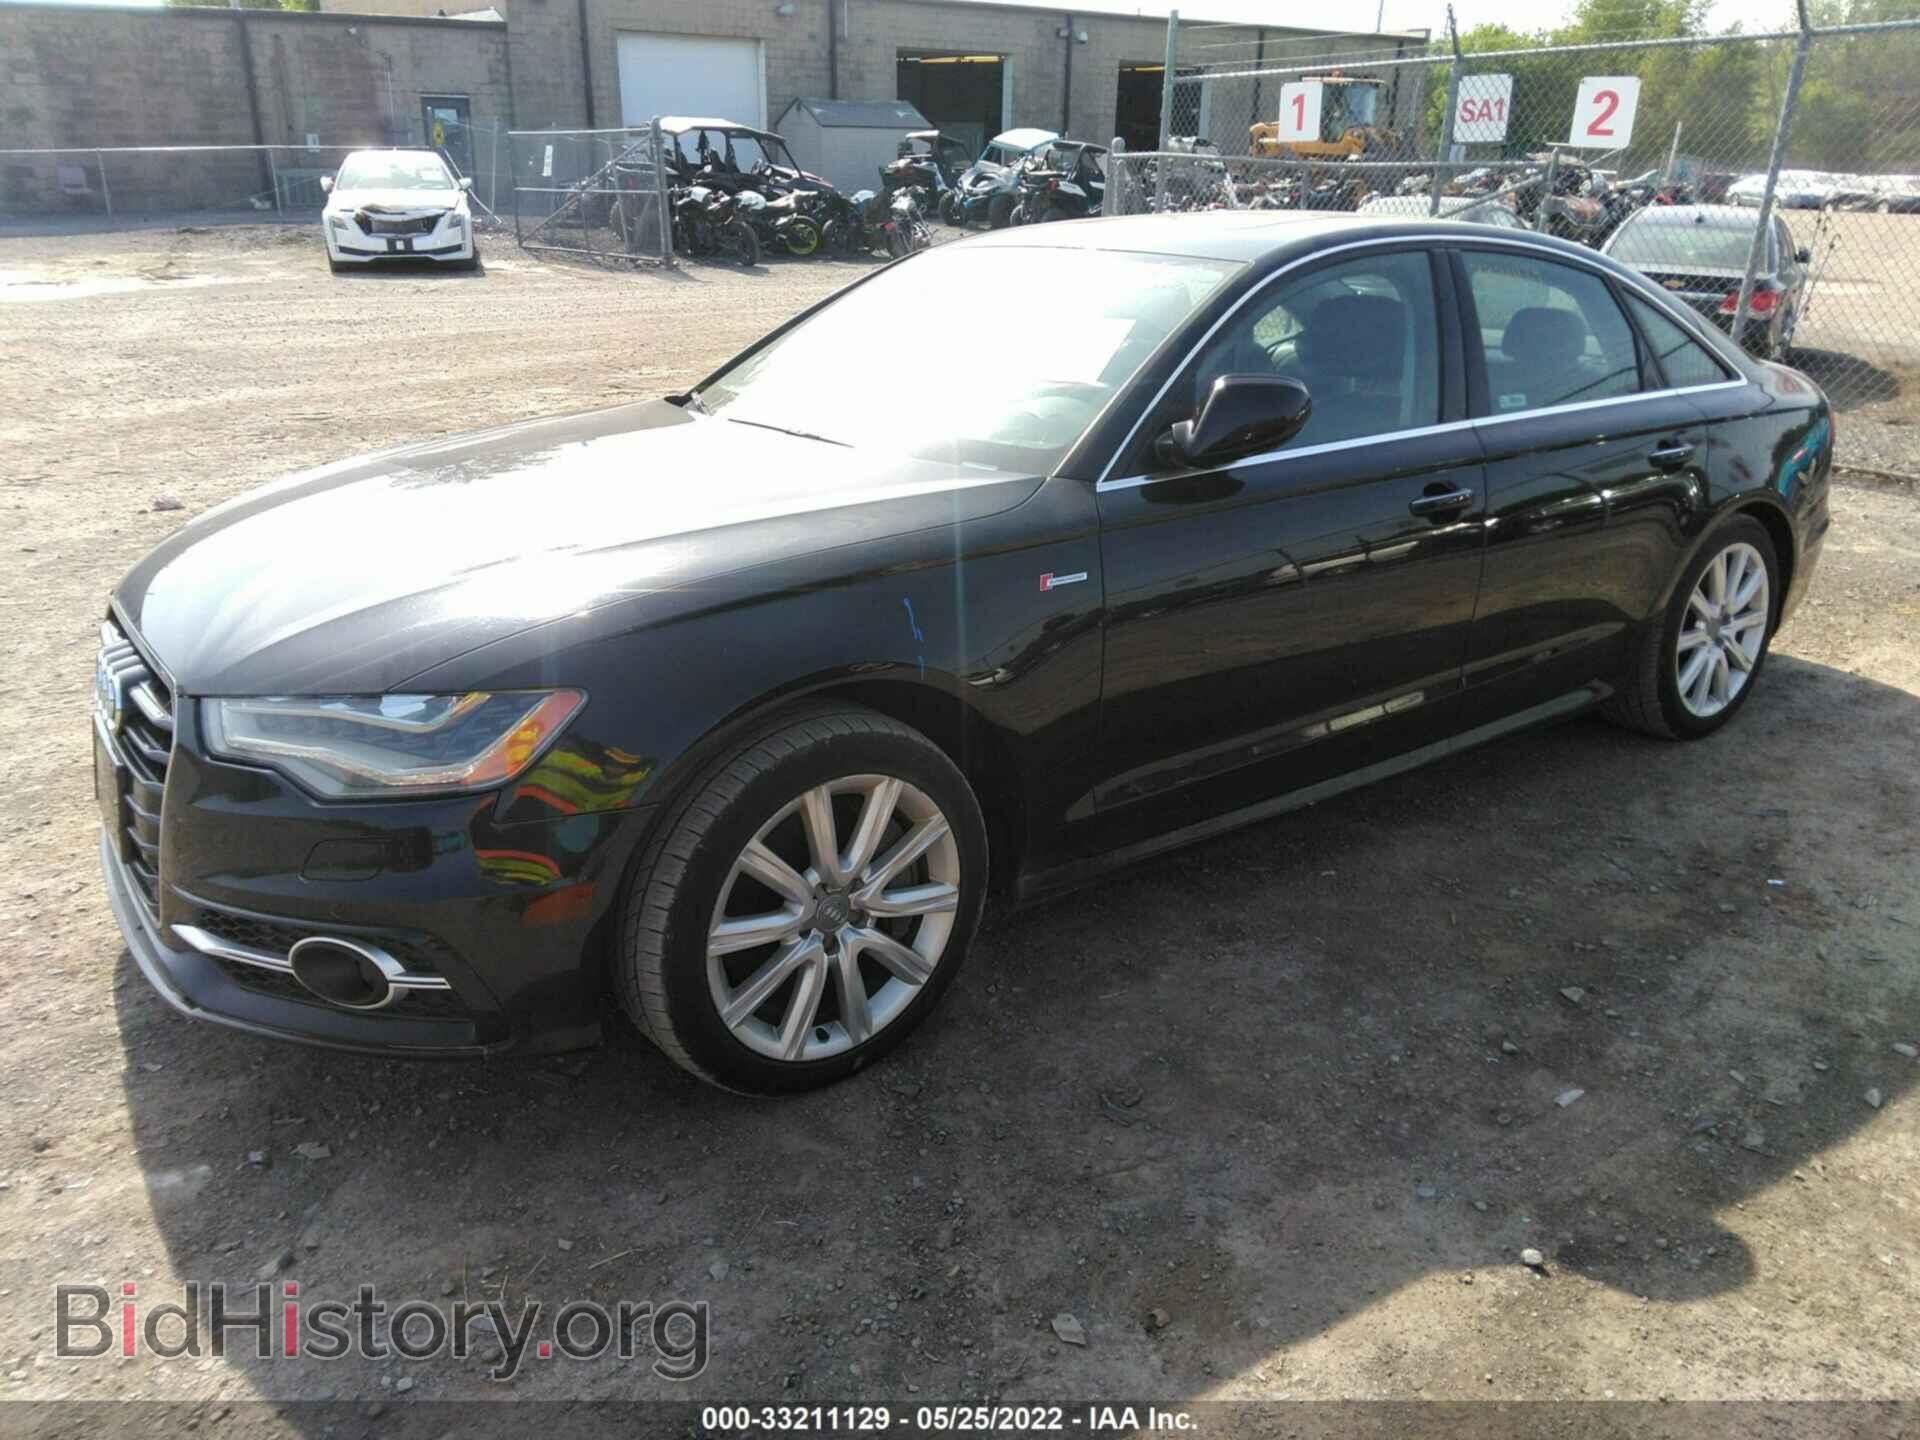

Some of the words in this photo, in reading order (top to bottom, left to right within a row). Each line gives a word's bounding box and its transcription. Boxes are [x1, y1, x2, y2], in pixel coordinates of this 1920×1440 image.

[1291, 93, 1305, 131] 1
[1460, 97, 1506, 124] SA1
[1586, 89, 1620, 137] 2
